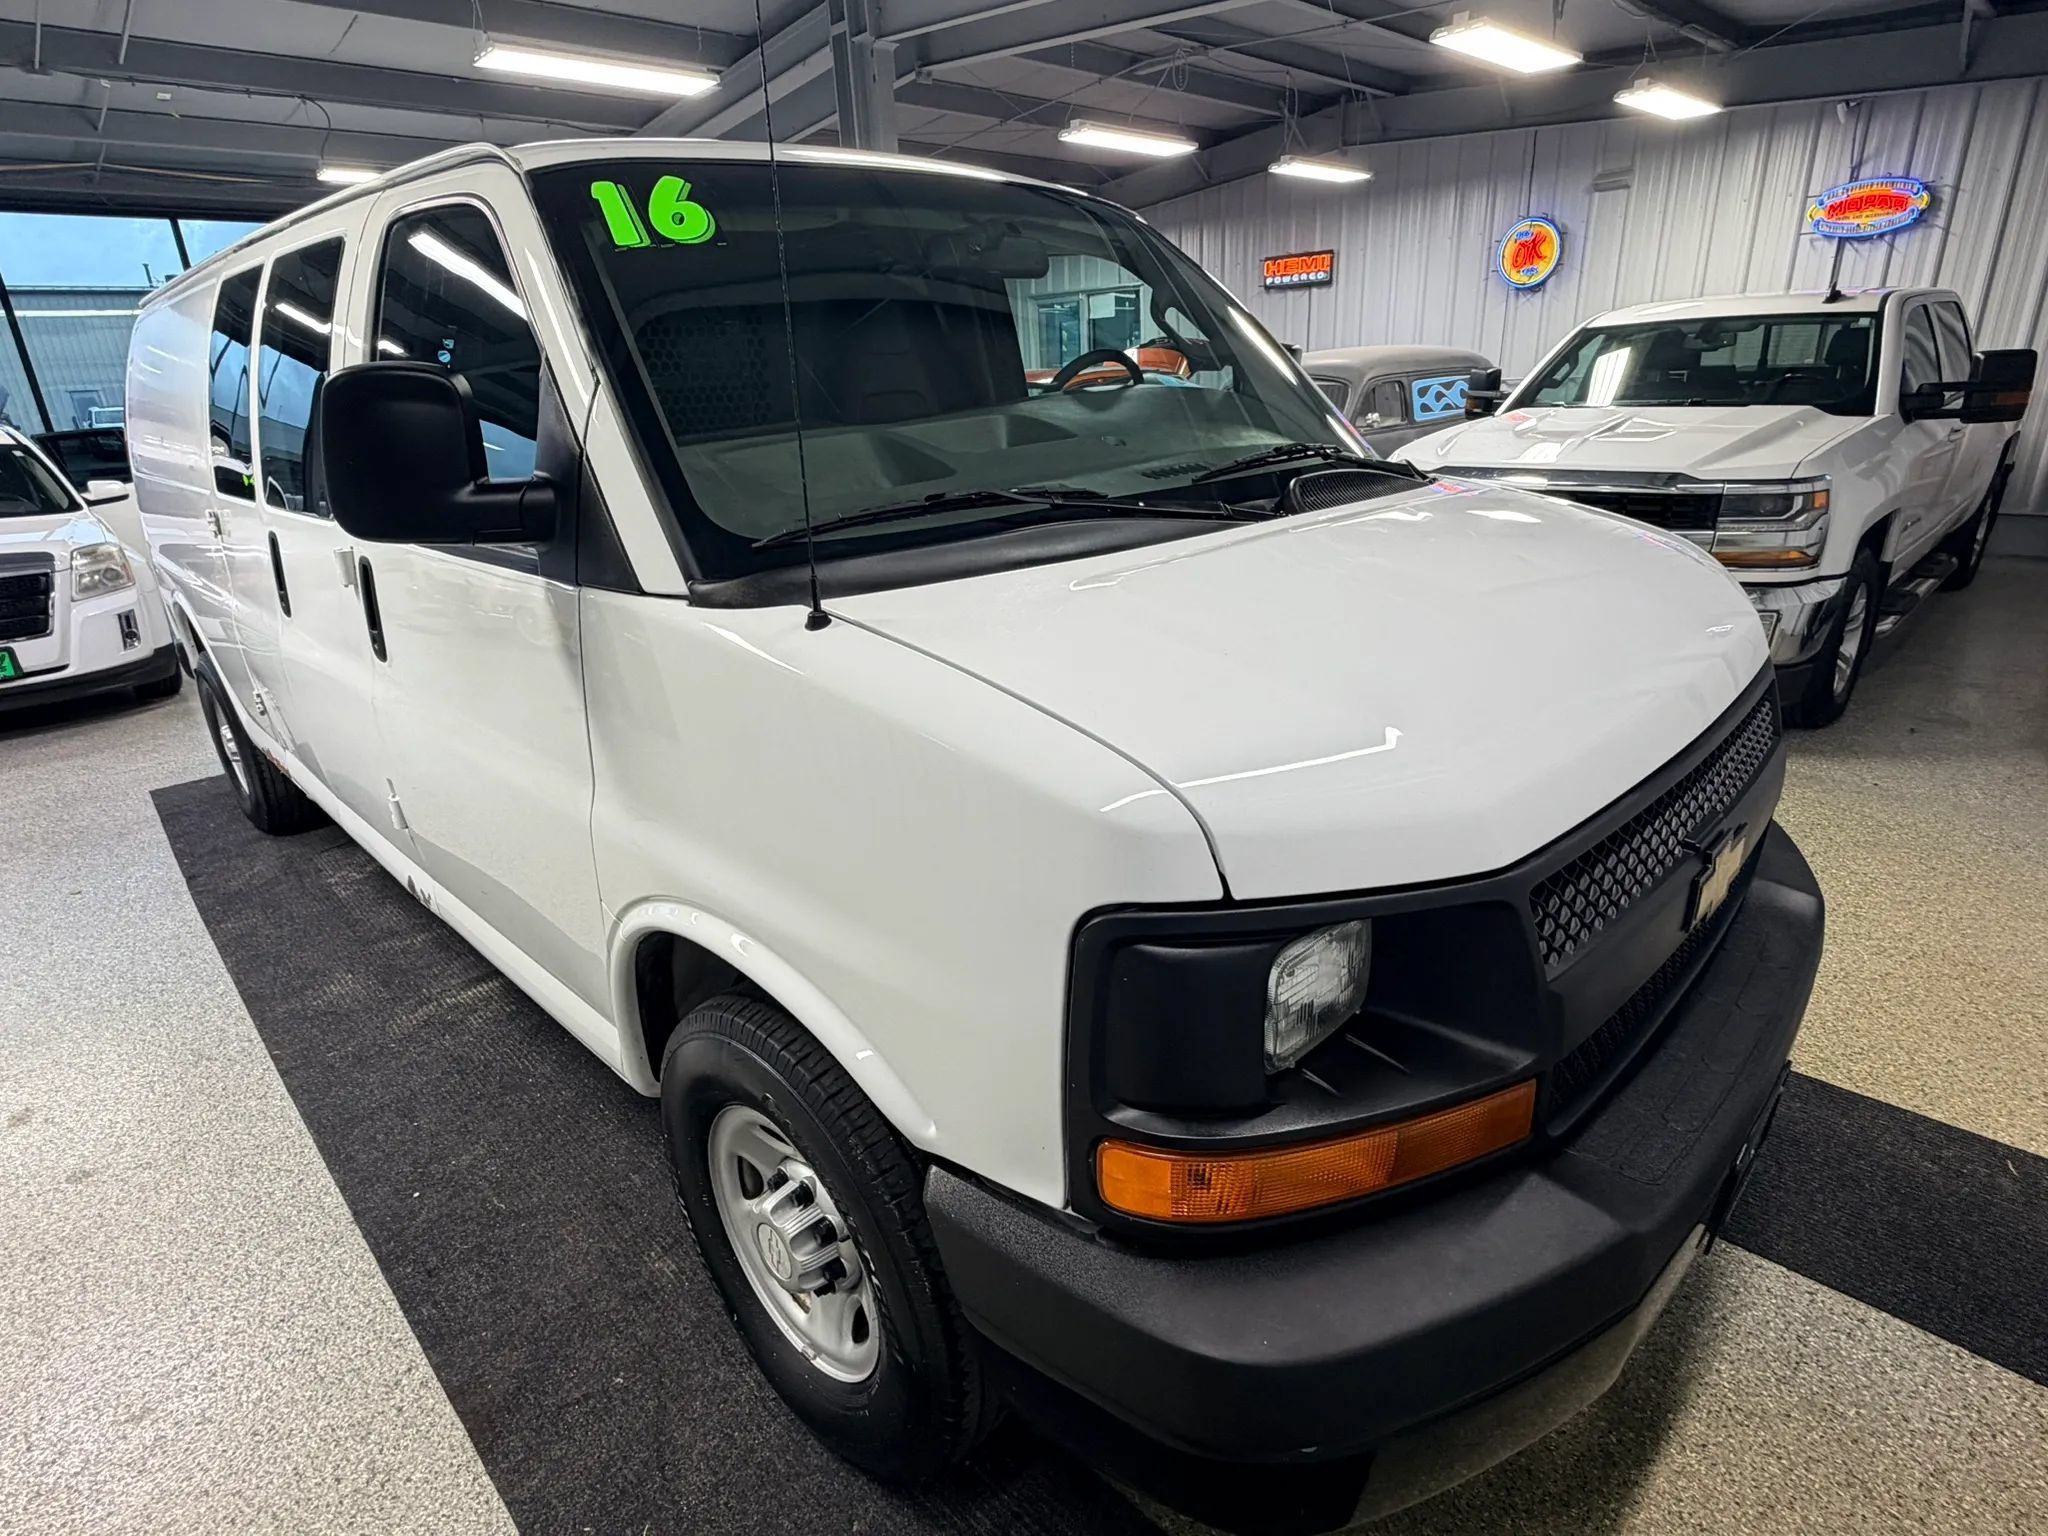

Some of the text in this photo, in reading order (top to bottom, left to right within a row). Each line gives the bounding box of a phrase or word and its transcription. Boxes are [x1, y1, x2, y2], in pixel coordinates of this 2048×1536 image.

[591, 175, 716, 248] 16
[1825, 194, 1909, 219] MOPAR
[1512, 230, 1548, 269] OK
